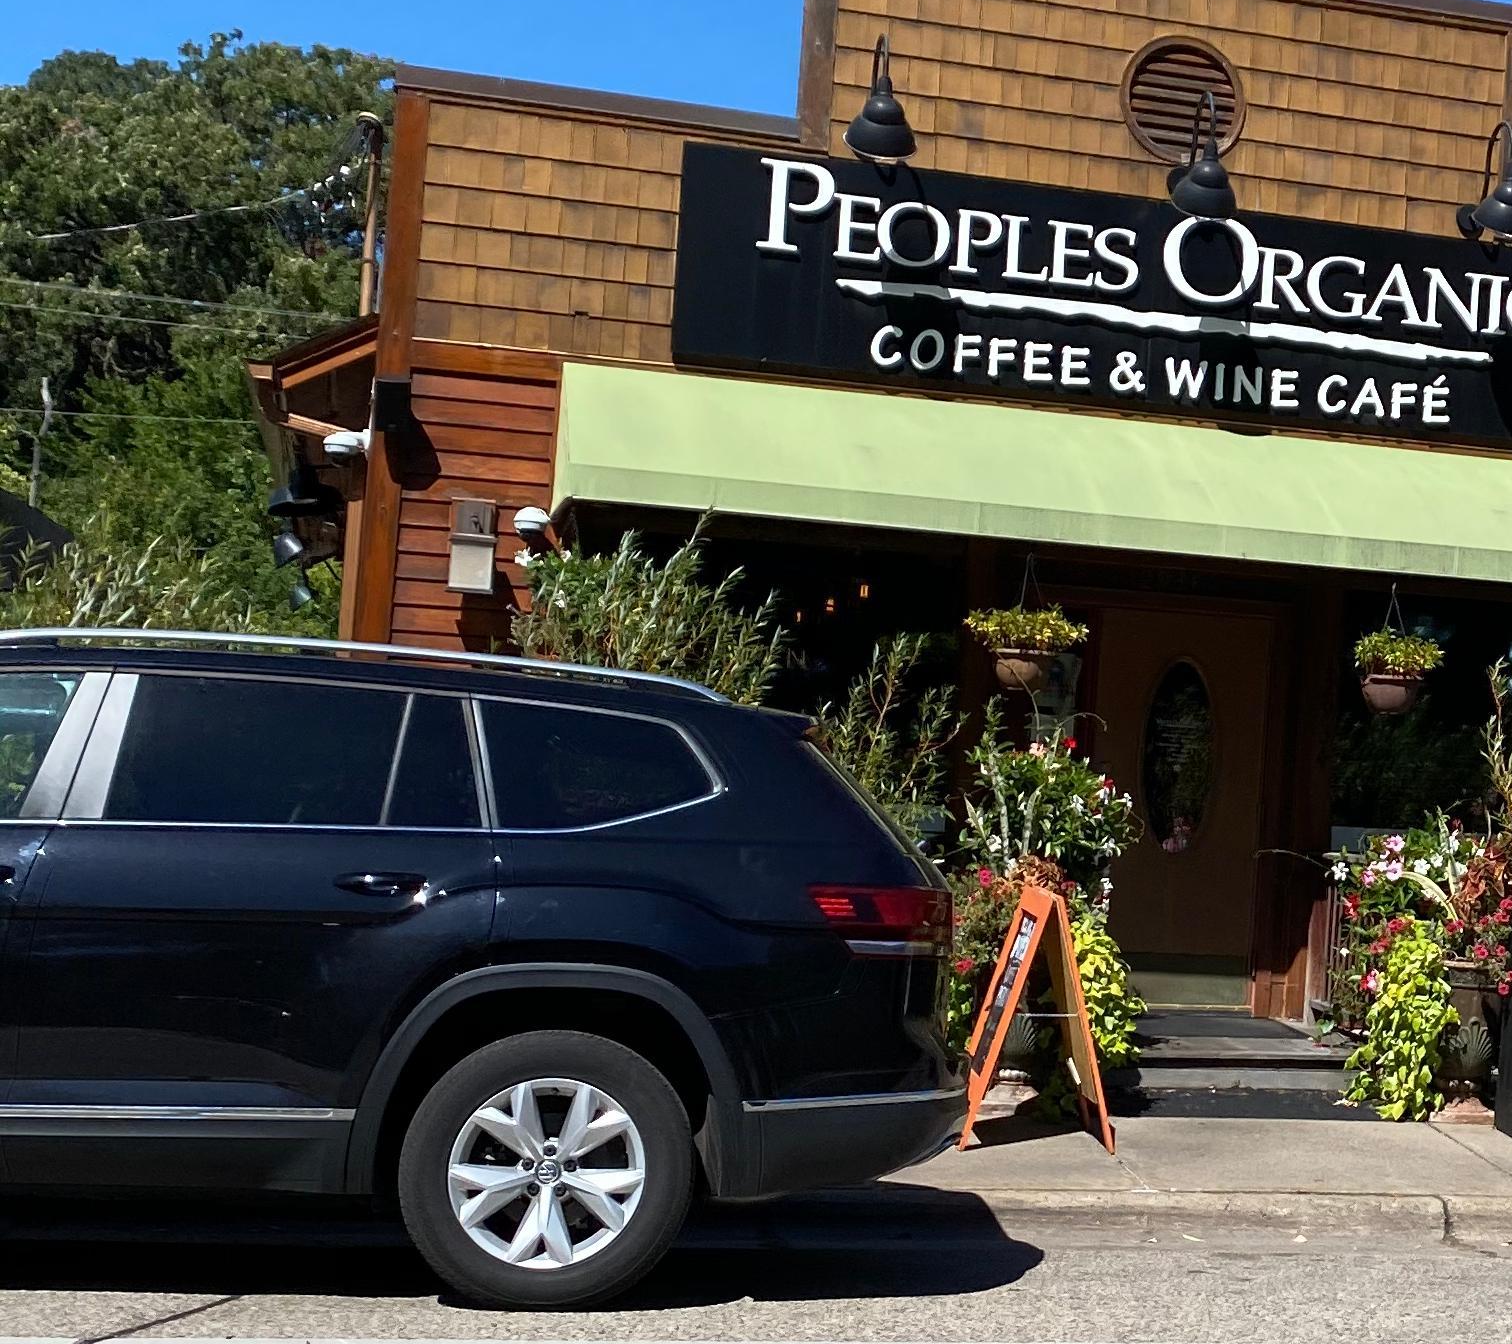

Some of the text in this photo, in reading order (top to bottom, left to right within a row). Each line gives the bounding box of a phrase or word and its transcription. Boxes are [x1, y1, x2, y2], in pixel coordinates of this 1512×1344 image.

[755, 157, 1140, 290] PEOPLES
[870, 324, 1451, 424] COFFEE & WINE CAFÉ
